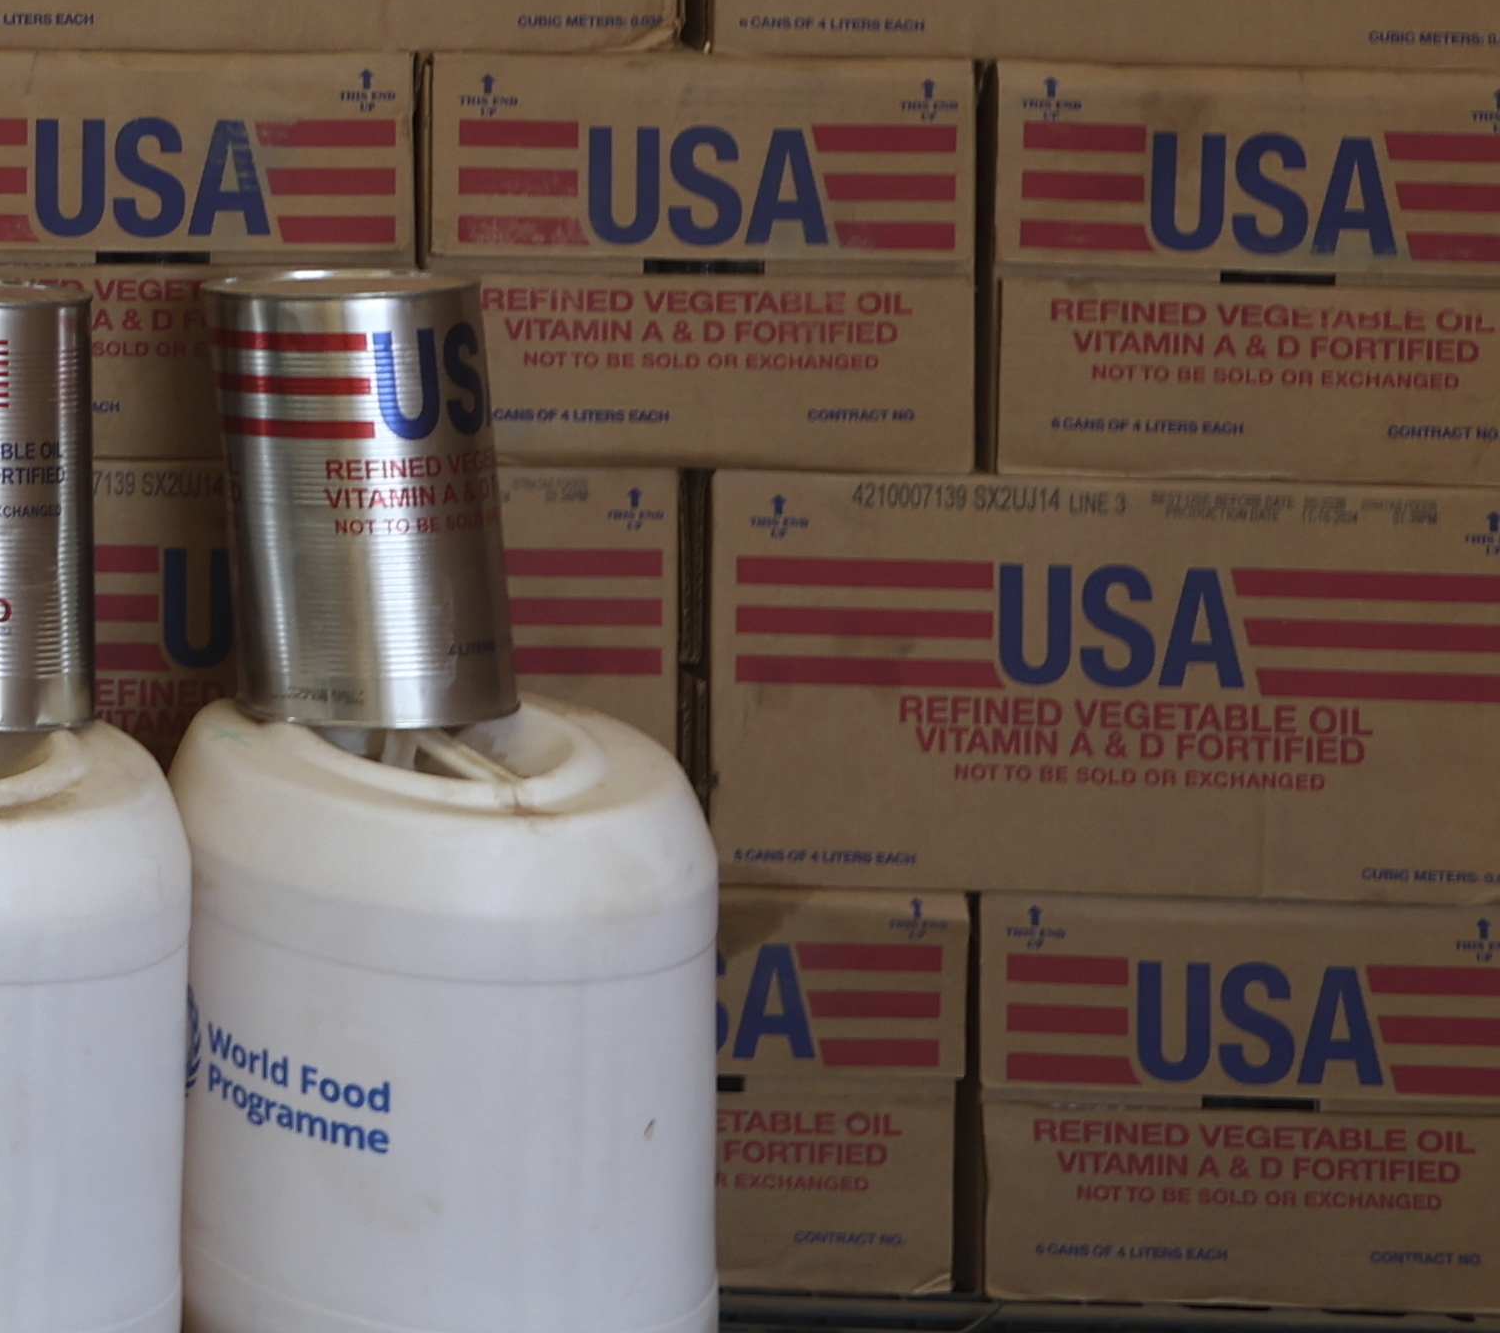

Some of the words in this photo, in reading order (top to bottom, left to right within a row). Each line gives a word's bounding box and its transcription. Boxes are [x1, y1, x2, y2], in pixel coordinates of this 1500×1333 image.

[372, 321, 491, 440] US
[40, 442, 63, 461] OIL
[325, 455, 442, 480] REFINED
[324, 485, 435, 510] VITAMIN
[442, 484, 459, 505] A
[334, 518, 377, 535] NOT
[383, 517, 410, 534] TO
[416, 514, 440, 532] BE
[998, 563, 1246, 689] USA
[208, 1021, 289, 1088] World
[301, 1064, 391, 1113] Food
[208, 1062, 390, 1154] Programme
